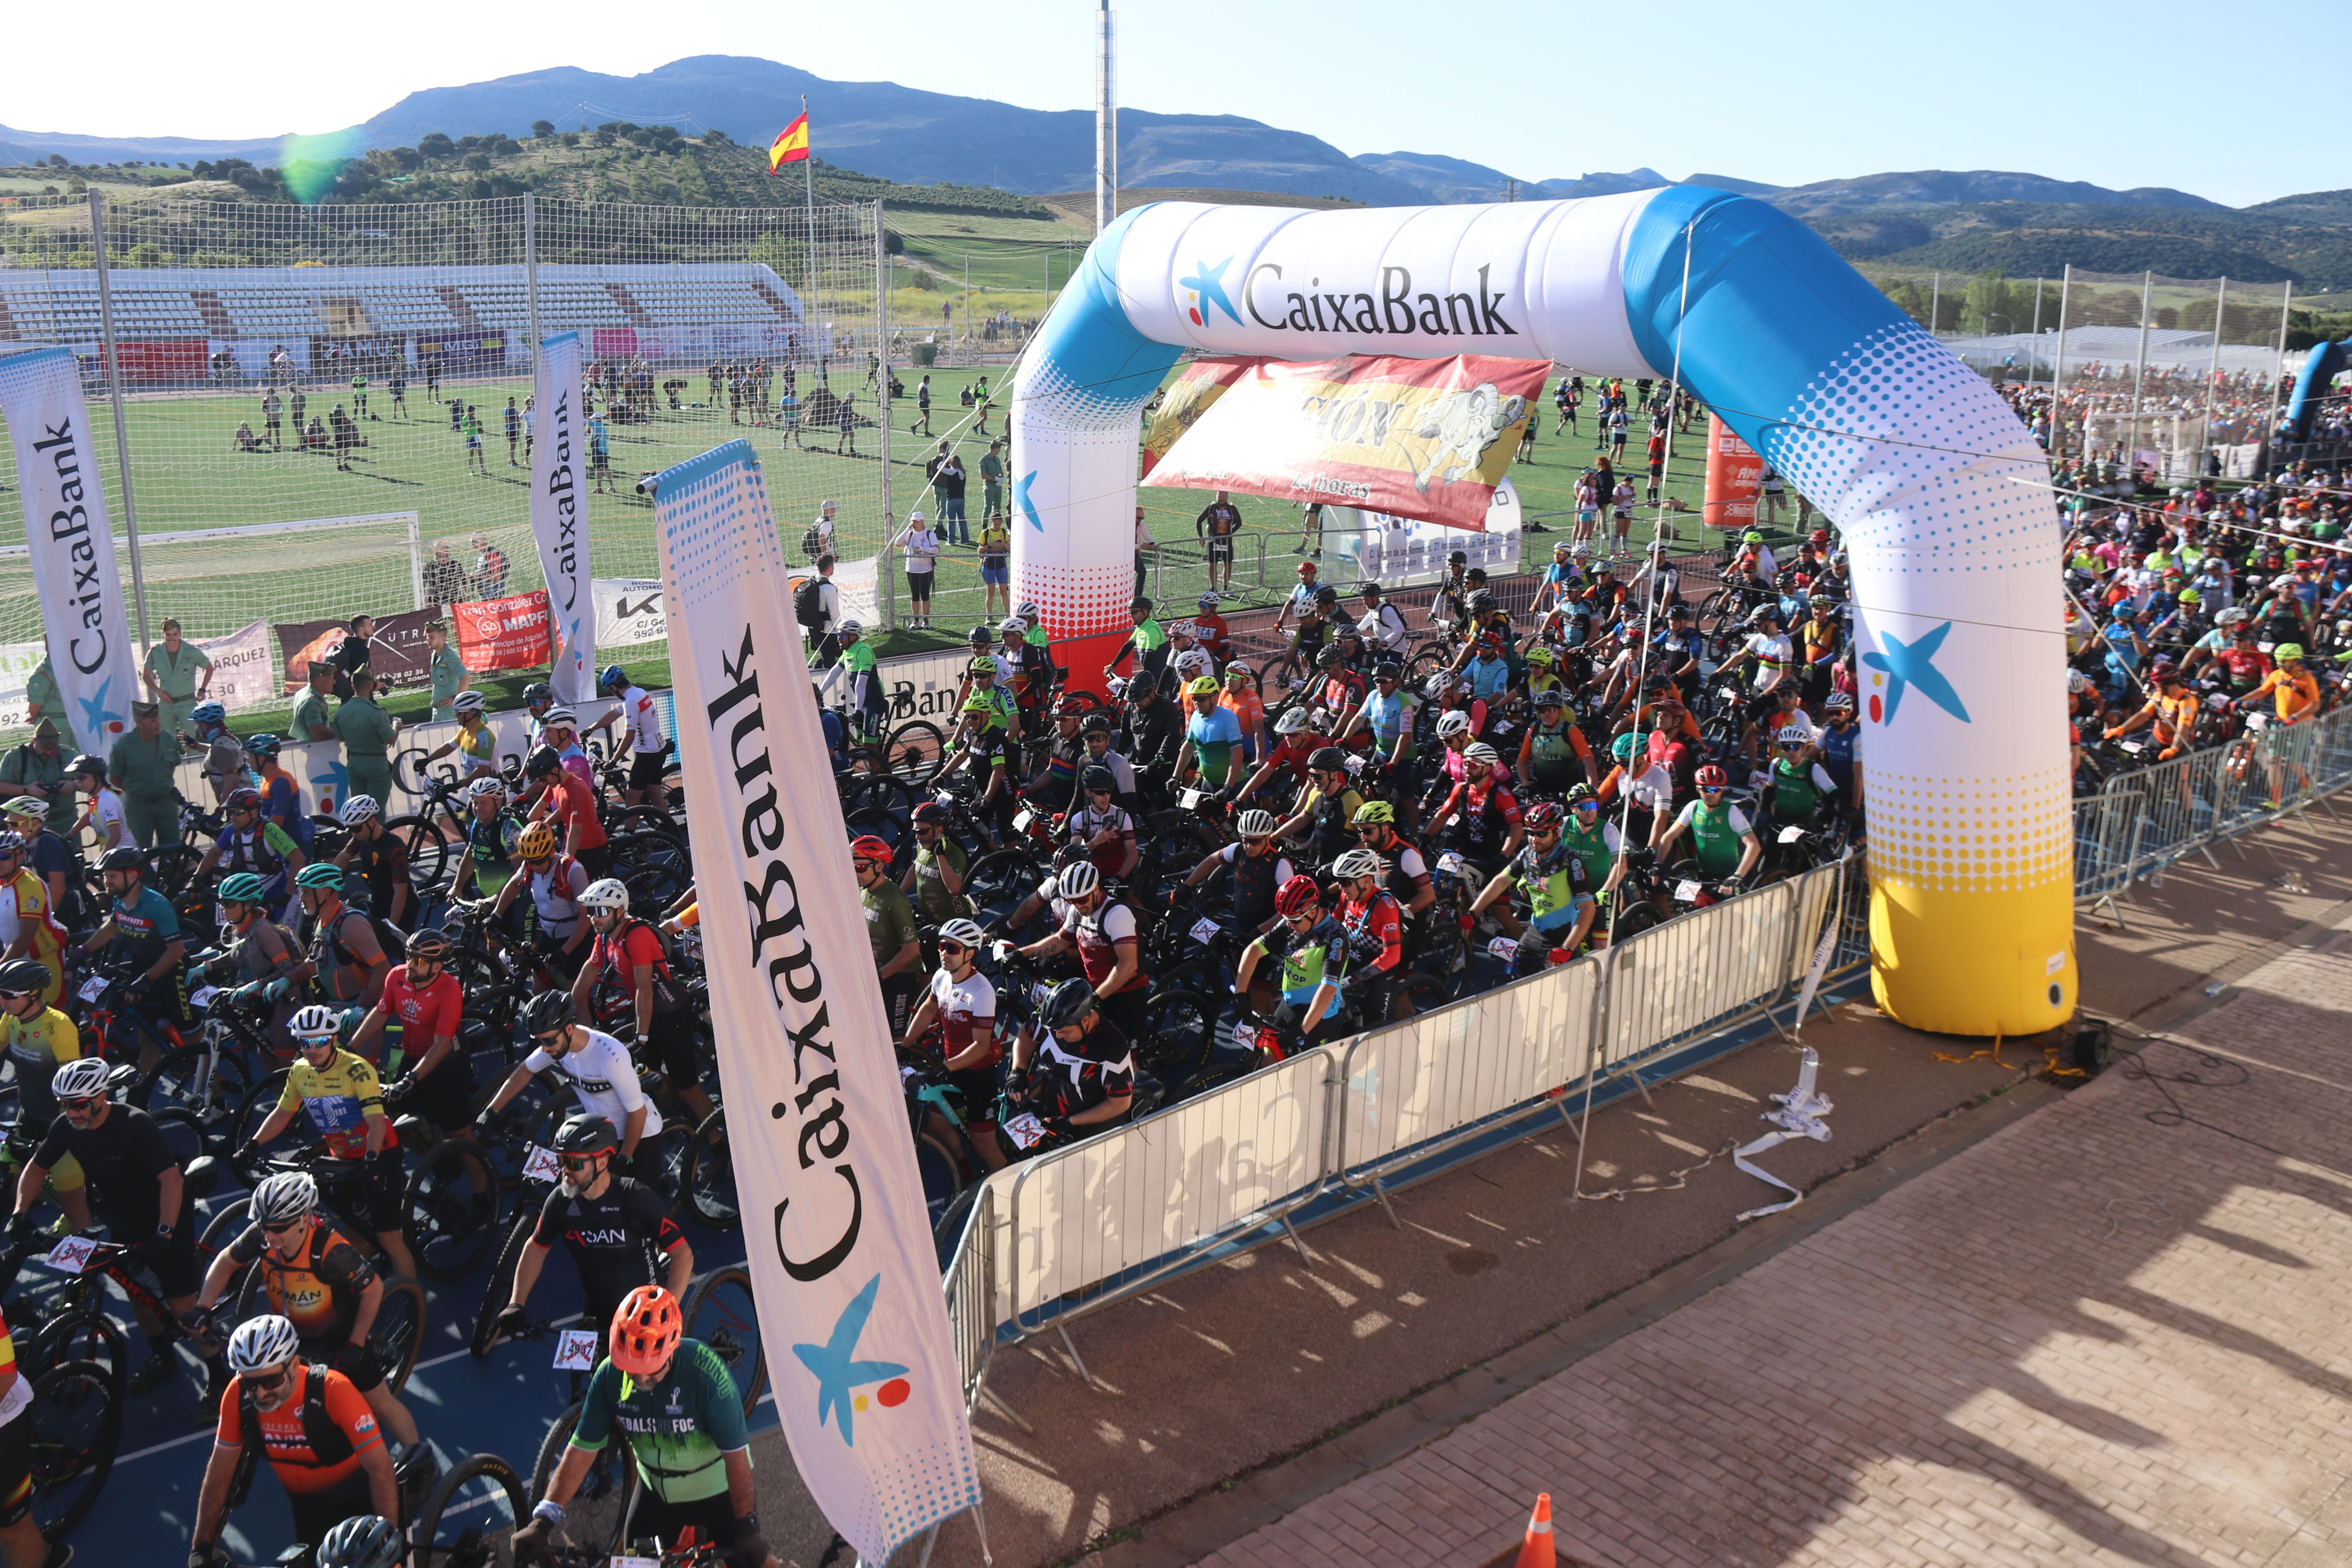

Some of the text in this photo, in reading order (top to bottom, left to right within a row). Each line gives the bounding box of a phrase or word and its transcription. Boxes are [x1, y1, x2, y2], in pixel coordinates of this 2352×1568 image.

[1245, 263, 1518, 336] CaixaBank
[1737, 468, 1757, 479] AM
[1290, 472, 1372, 499] 24 horas
[33, 416, 106, 675] CaixaBank
[487, 597, 533, 614] González
[634, 629, 655, 639] 952
[218, 683, 236, 696] 30
[920, 864, 940, 879] TIESOS
[118, 913, 144, 926] SRAM
[708, 623, 861, 1281] CaixaBank
[657, 981, 675, 1003] JUCHABE
[402, 998, 423, 1011] INDALO
[895, 994, 907, 1018] TIESOS
[596, 1037, 620, 1063] RYSEL
[582, 1082, 611, 1092] RYSEL
[109, 1266, 165, 1318] GHOST
[568, 1345, 593, 1356] 4937
